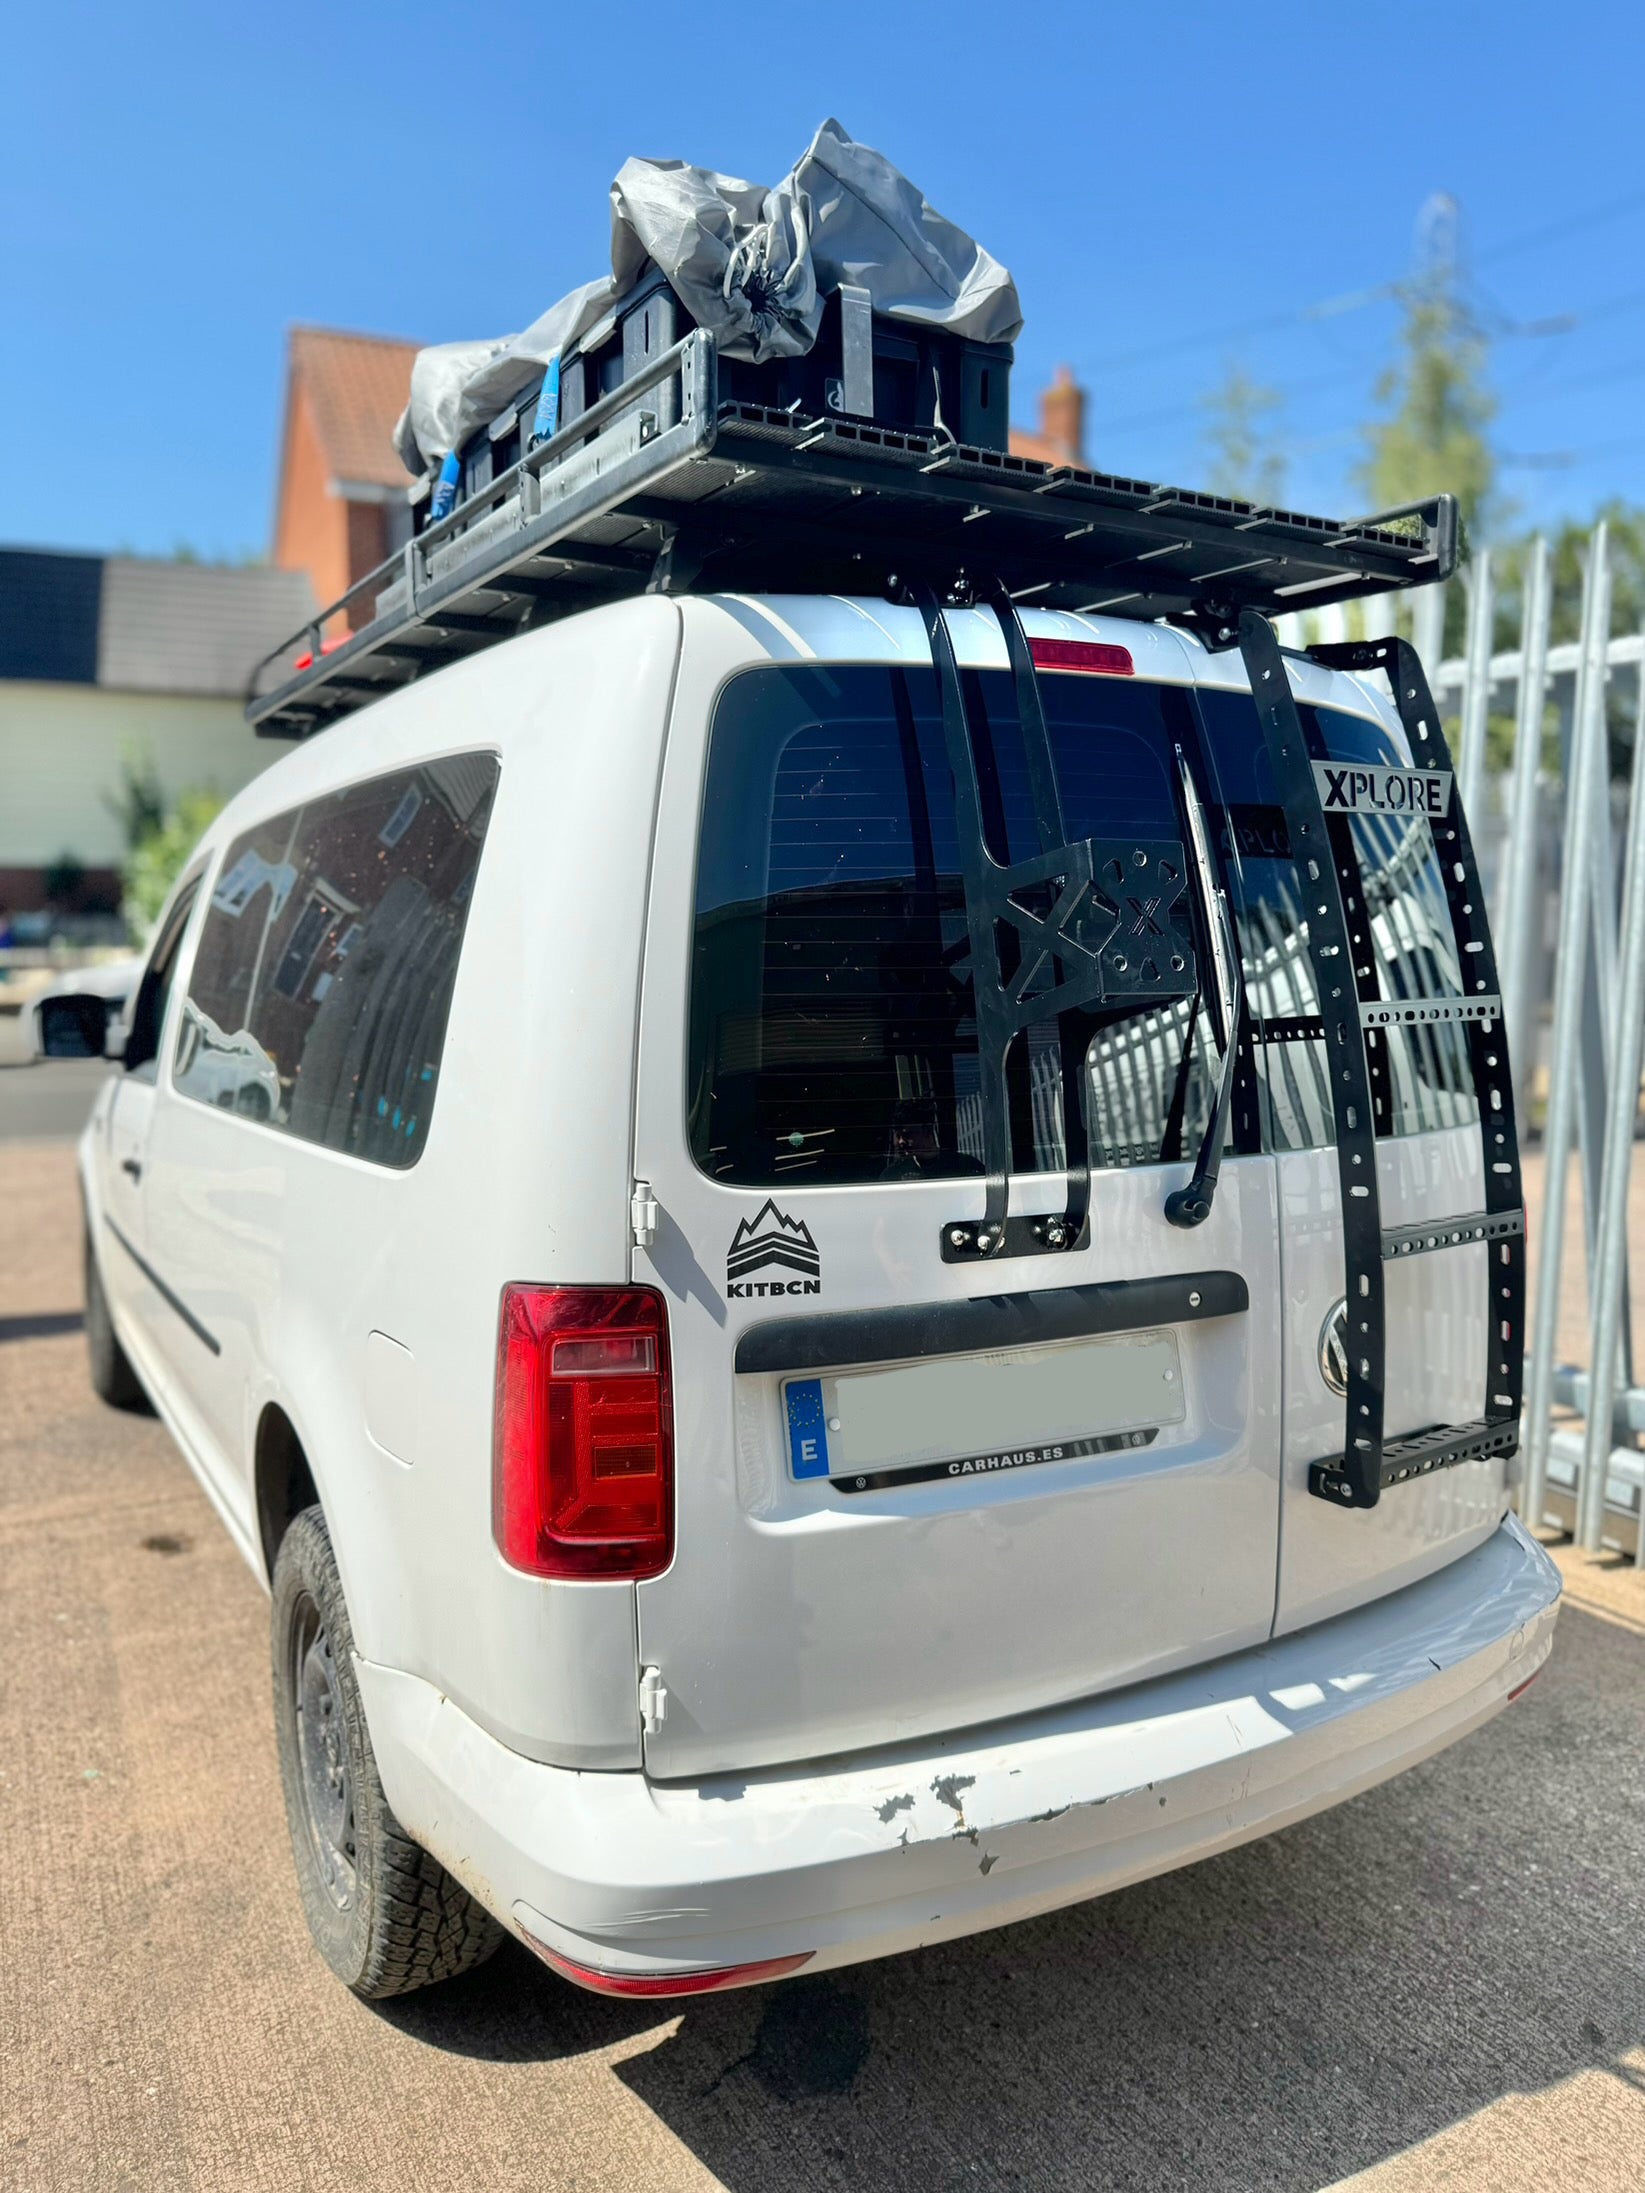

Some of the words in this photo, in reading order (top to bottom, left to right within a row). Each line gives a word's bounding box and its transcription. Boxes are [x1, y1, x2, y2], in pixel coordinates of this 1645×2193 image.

[1323, 769, 1442, 812] XPLORE
[727, 1280, 820, 1298] KITBCN
[801, 1438, 818, 1461] E
[948, 1447, 1064, 1475] CARHAUS.ES
